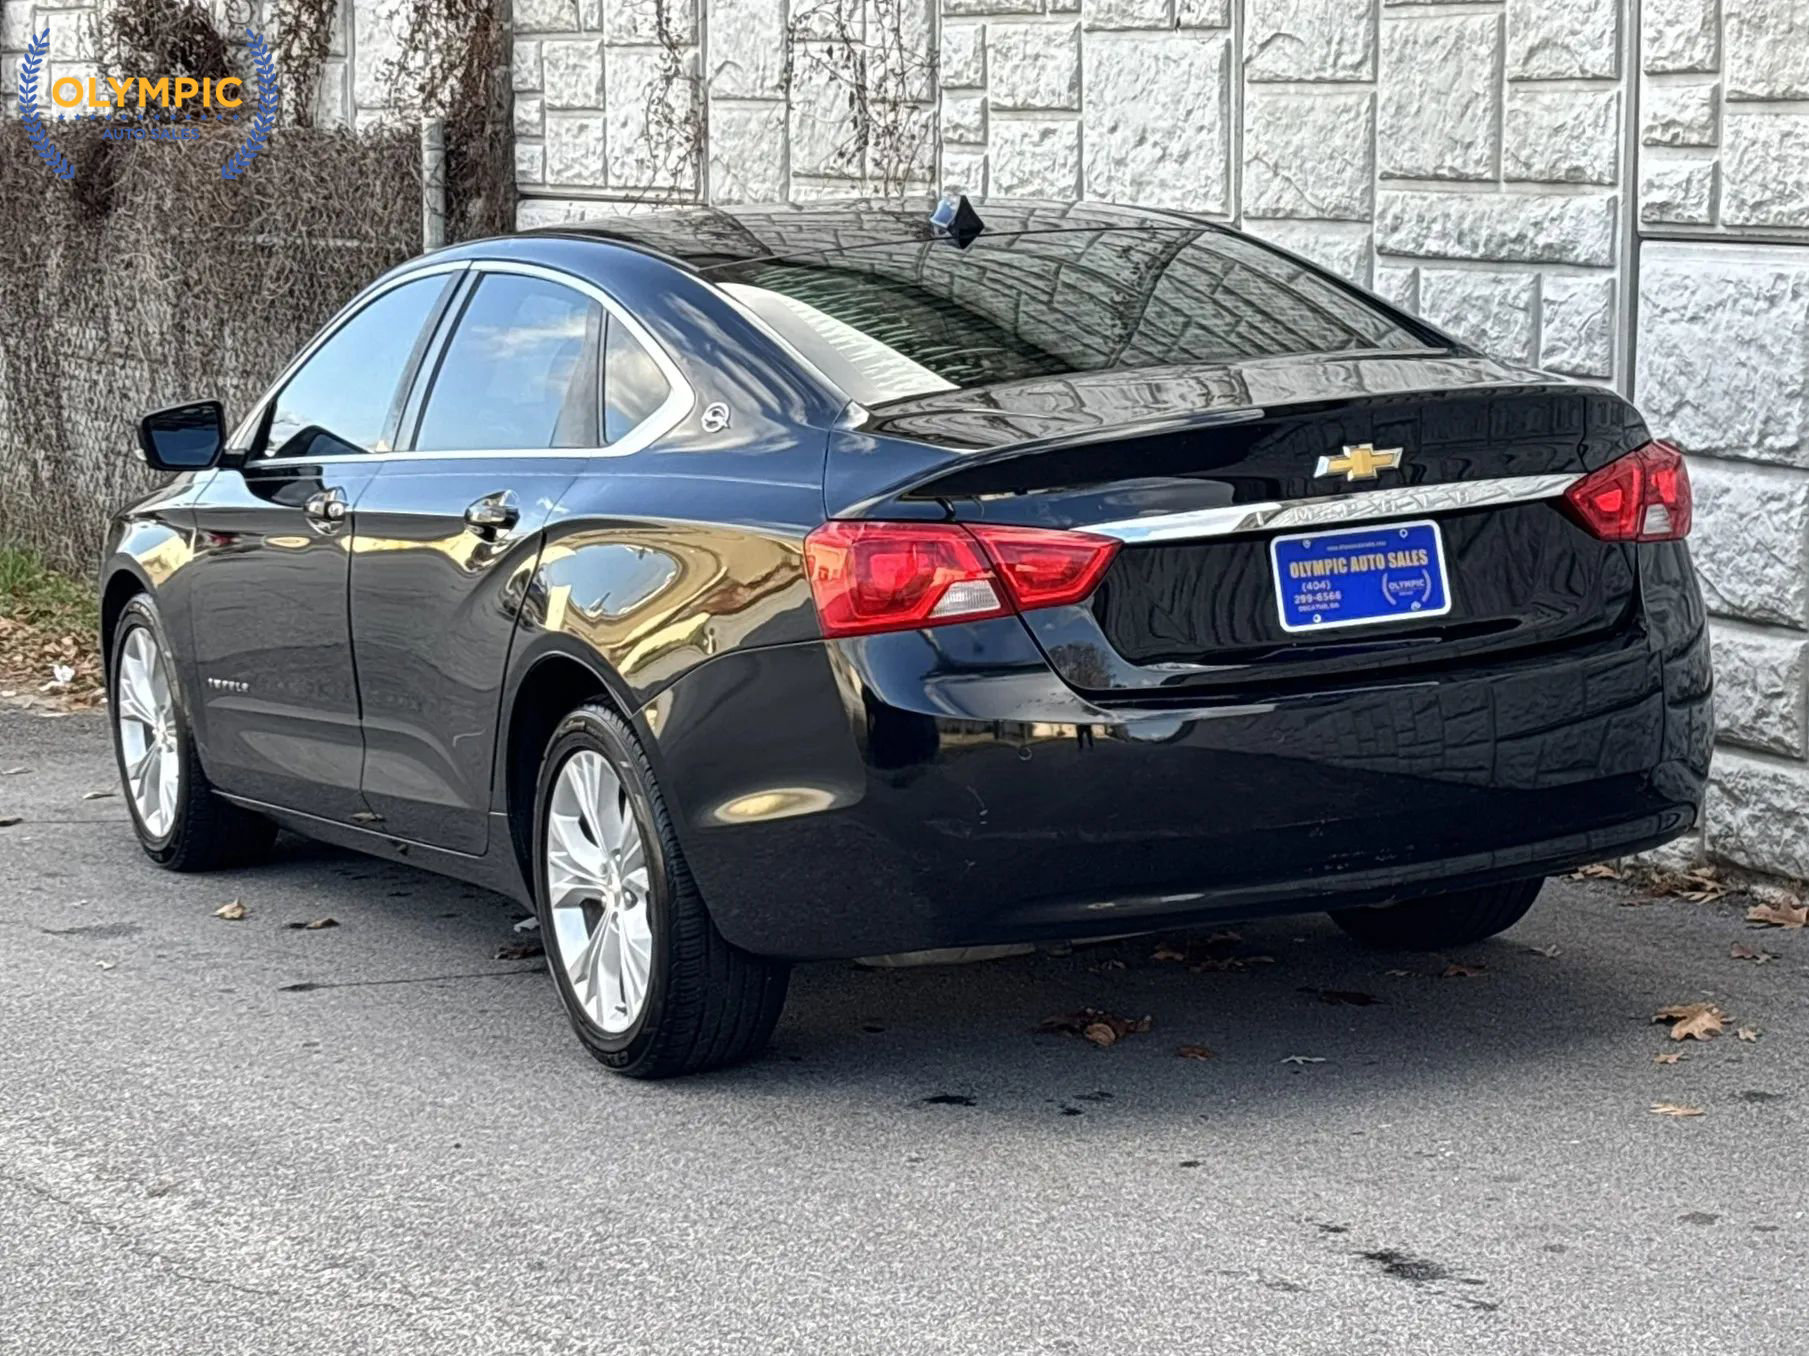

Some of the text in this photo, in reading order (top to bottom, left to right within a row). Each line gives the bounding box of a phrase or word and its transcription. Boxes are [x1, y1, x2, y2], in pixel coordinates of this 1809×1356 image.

[1289, 548, 1429, 579] OLYMPIC AUTO SALES
[1302, 580, 1331, 593] (404)
[1388, 578, 1426, 590] OLYMPIC
